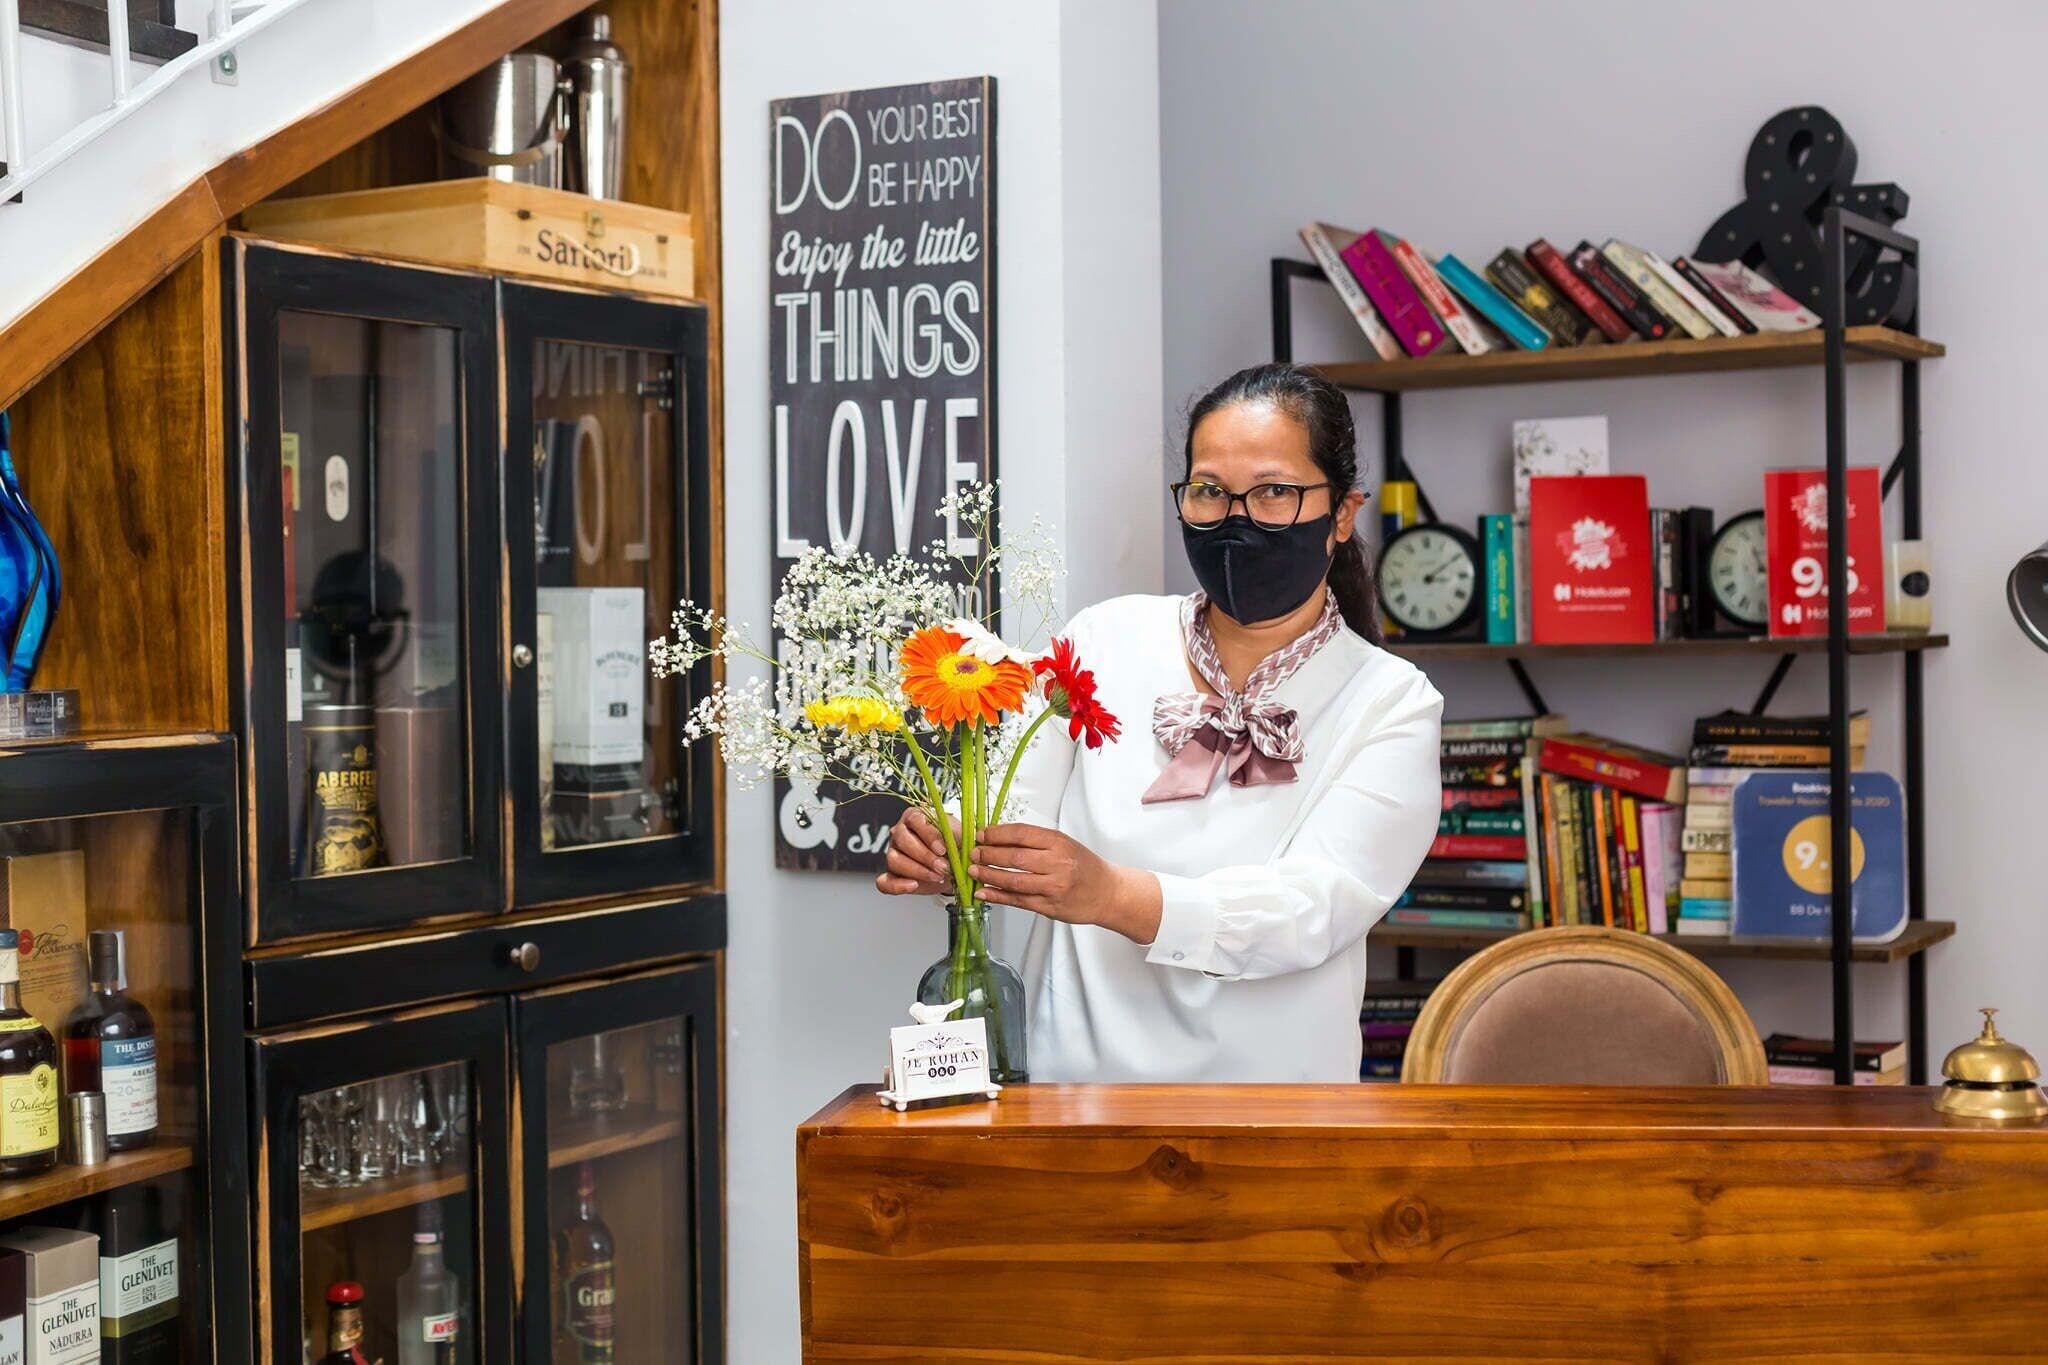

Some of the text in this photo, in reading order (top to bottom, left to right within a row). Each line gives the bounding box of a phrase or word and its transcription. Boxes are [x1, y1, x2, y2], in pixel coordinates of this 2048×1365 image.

[867, 97, 982, 146] YOUR BEST
[775, 108, 862, 215] DO
[868, 153, 982, 208] BE HAPPY
[537, 229, 626, 270] Sartori
[775, 216, 981, 290] Enjoy the little
[774, 279, 981, 385] THINGS
[775, 397, 979, 559] LOVE
[316, 771, 378, 788] ABERFE
[1794, 840, 1829, 871] 9.
[114, 1040, 154, 1054] THE DIS
[121, 1260, 174, 1292] GLENLIVET
[141, 1254, 157, 1269] THE
[62, 1298, 79, 1312] THE
[577, 1286, 614, 1307] Gra
[42, 1302, 97, 1335] GLENLIVET
